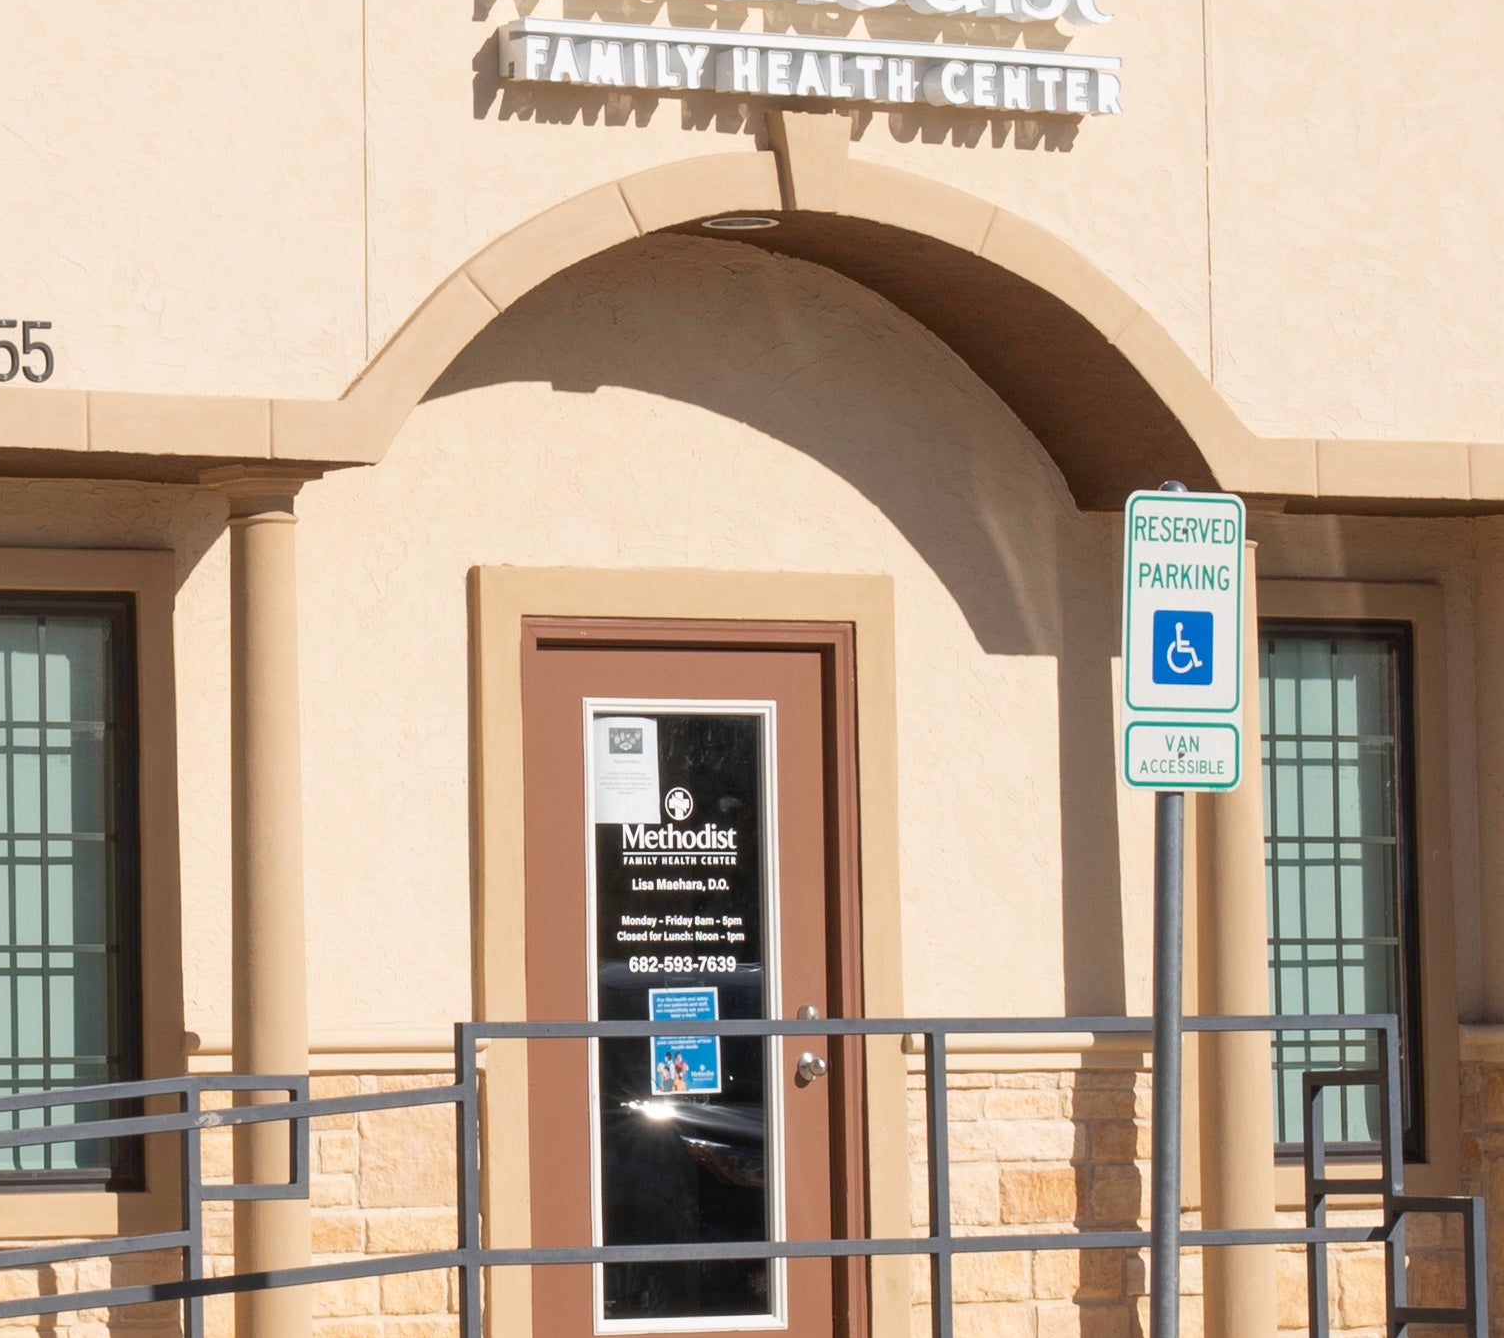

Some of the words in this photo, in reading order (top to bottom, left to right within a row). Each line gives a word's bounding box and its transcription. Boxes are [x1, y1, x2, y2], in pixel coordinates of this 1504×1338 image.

[525, 35, 709, 89] FAMILY
[733, 47, 916, 103] HEALTH
[941, 60, 1122, 114] CENTER
[1134, 515, 1236, 545] RESERVED
[1138, 562, 1230, 591] PARKING
[1165, 735, 1200, 753] VAN
[1139, 759, 1225, 775] ACCESSIBLE
[622, 822, 738, 850] Methodist
[623, 856, 657, 866] FAMILY
[661, 856, 697, 866] HEALTH
[700, 856, 737, 866] CENTER
[632, 878, 654, 891] Lisa
[656, 878, 706, 892] Maehara,
[708, 878, 730, 891] D.O.
[621, 915, 657, 928] Monday
[665, 915, 693, 928] Friday
[694, 916, 714, 926] 8am
[722, 916, 742, 928] 5pm
[616, 931, 648, 942] Closed
[649, 931, 662, 942] for
[663, 931, 694, 942] Lunch:
[695, 931, 719, 942] Noon
[727, 931, 745, 943] 1pm
[628, 956, 737, 973] 682-593-7639
